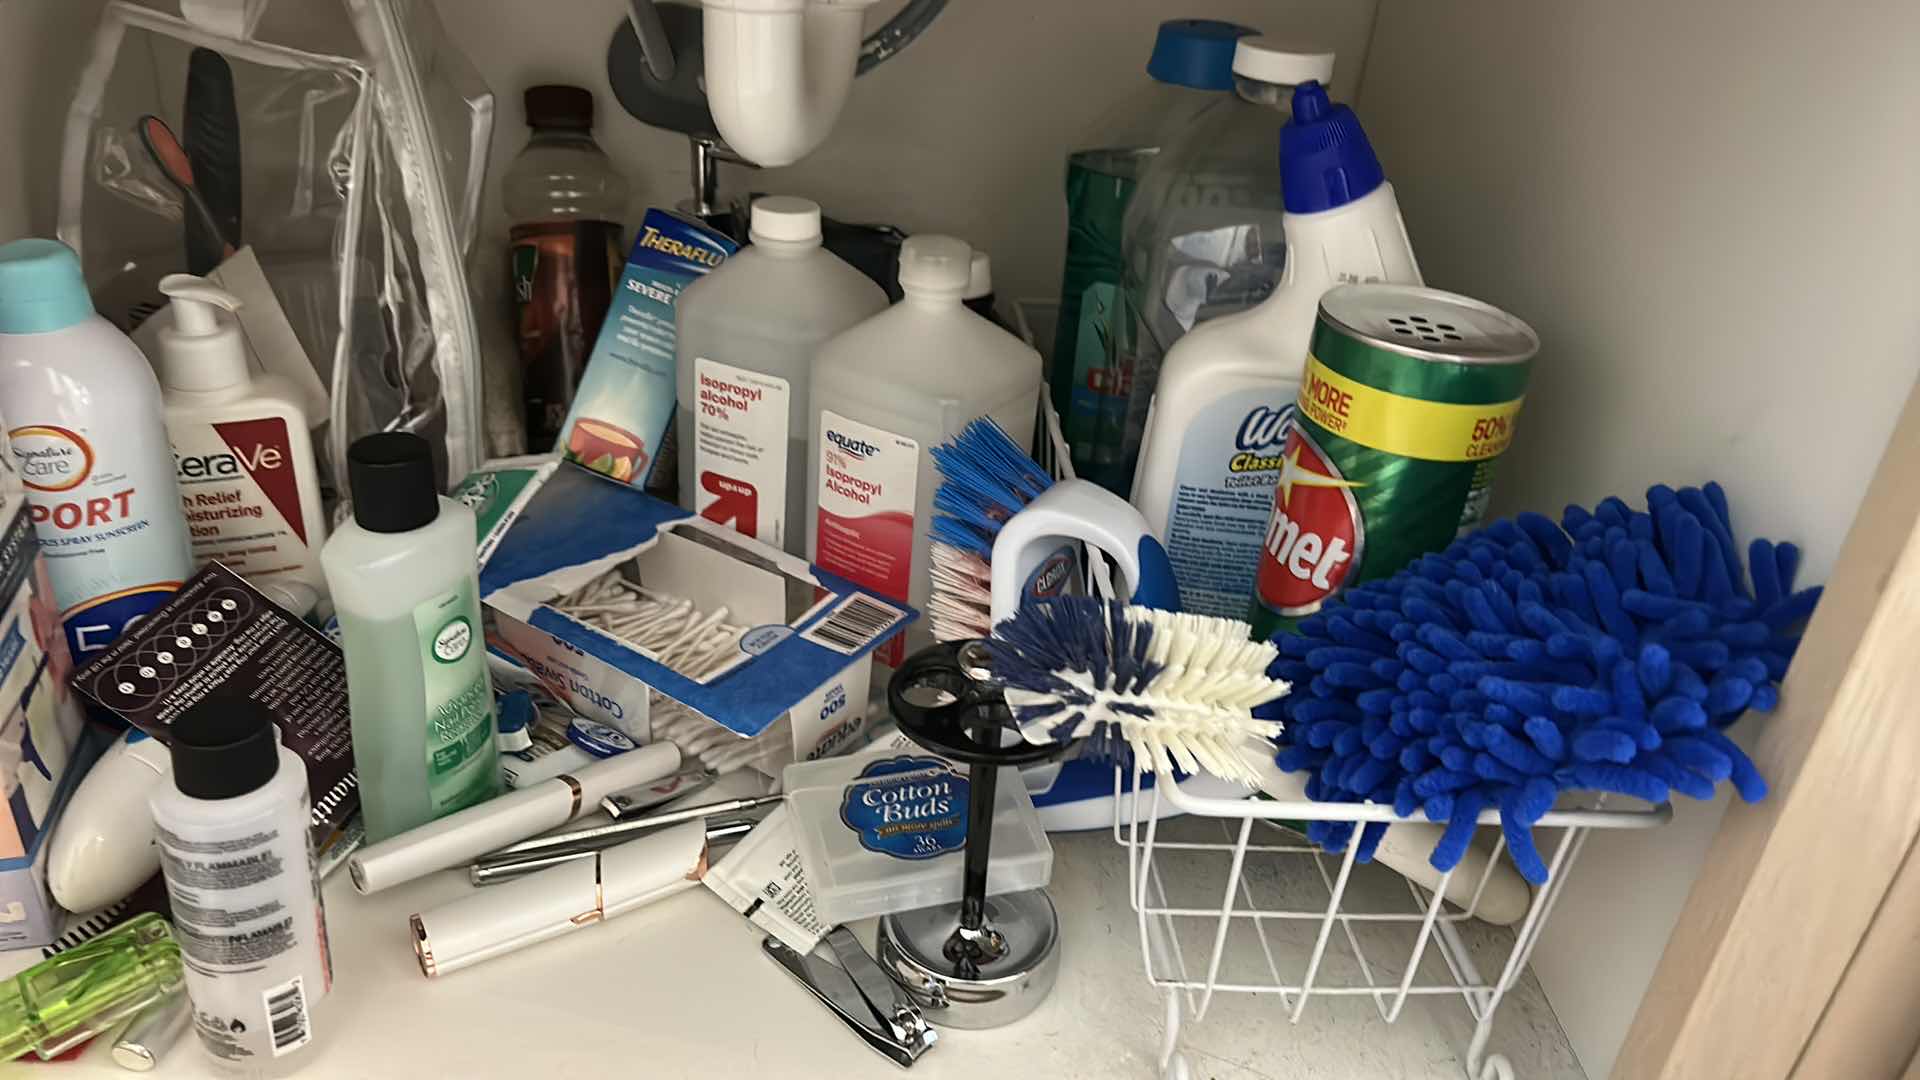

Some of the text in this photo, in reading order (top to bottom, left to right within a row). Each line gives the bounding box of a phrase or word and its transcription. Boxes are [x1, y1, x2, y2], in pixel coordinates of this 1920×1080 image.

[700, 373, 762, 400] Isopropyl
[1311, 373, 1353, 417] MORE
[700, 389, 748, 411] alcohol
[700, 401, 729, 420] 70%
[827, 430, 874, 456] equate
[24, 461, 69, 475] care
[176, 443, 282, 477] eraVe
[826, 464, 882, 496] Isopropyl
[826, 479, 870, 504] Alcohol
[31, 488, 135, 530] PORT
[195, 490, 241, 506] Relief
[187, 505, 263, 521] isturizing
[191, 524, 220, 537] tion
[1265, 508, 1350, 590] met
[520, 655, 567, 690] Swab
[570, 680, 624, 718] Cotton
[821, 694, 845, 720] 500
[863, 782, 952, 807] Cotton
[876, 797, 949, 823] Buds
[914, 835, 937, 846] 36
